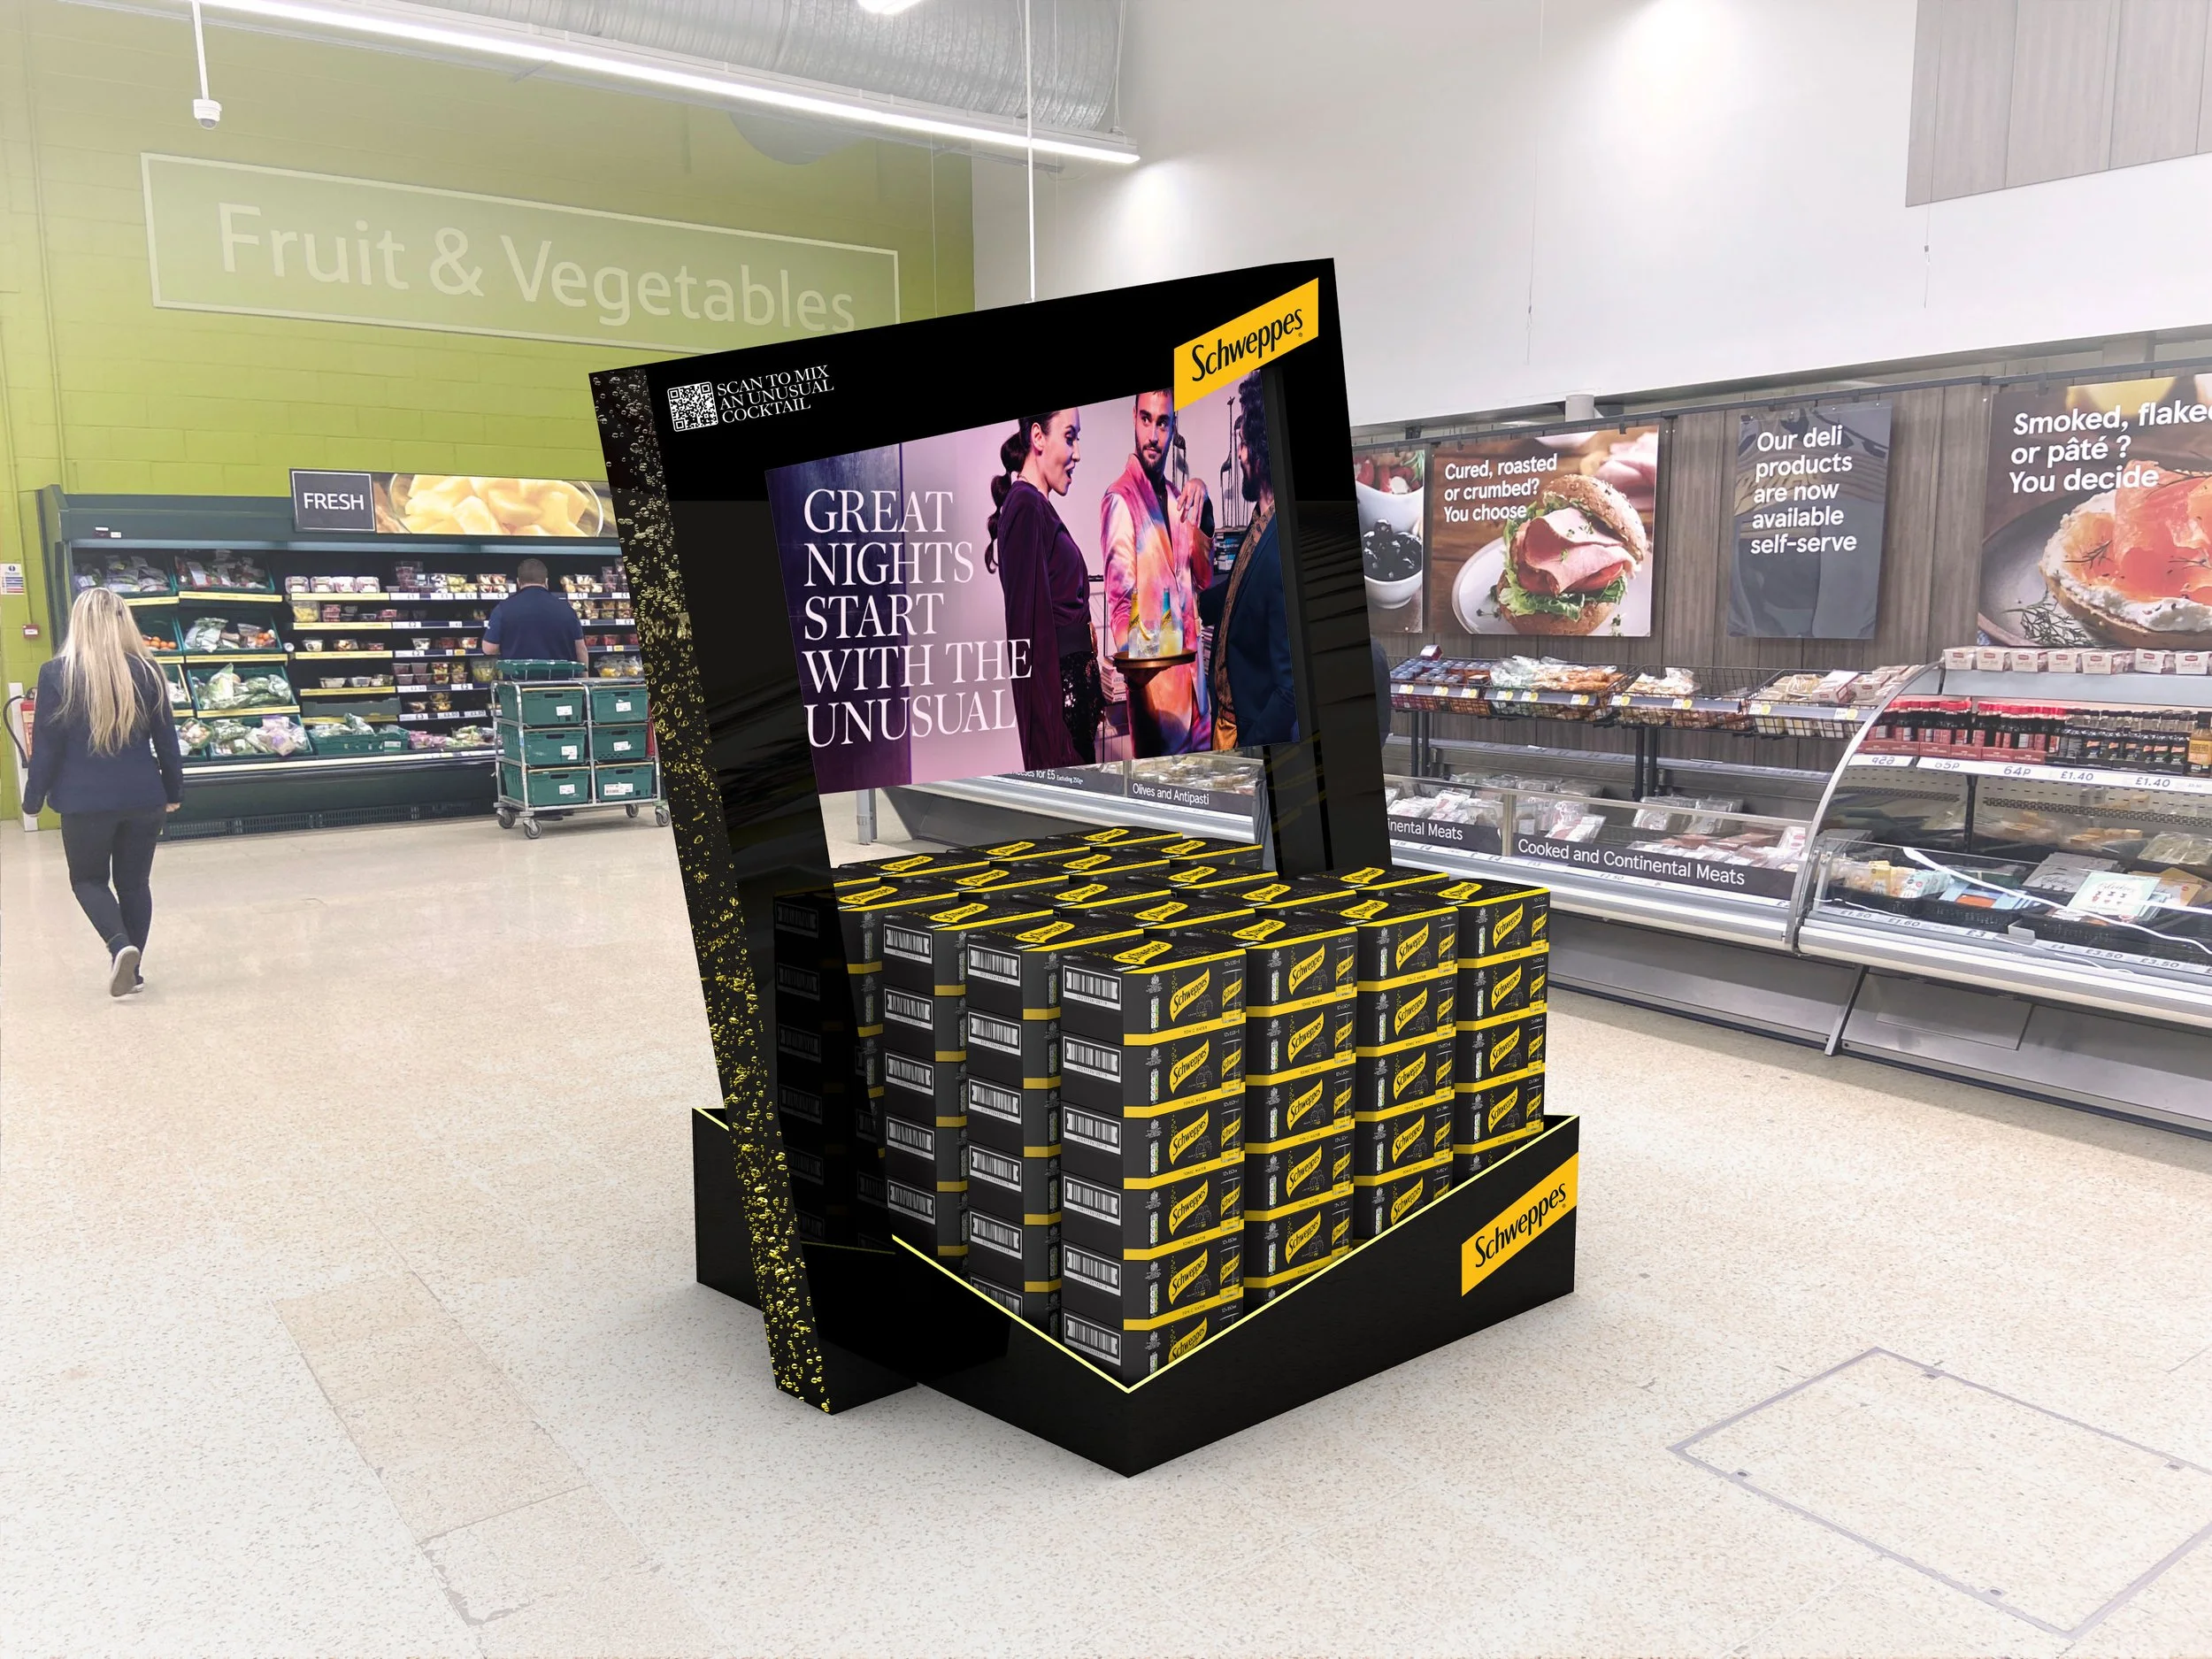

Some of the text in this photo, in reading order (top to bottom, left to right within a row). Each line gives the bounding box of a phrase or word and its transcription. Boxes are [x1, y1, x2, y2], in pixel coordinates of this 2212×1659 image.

[218, 202, 856, 333] Fruit & Vegetables
[1192, 309, 1303, 381] Schweppes
[717, 365, 830, 396] SCAN TO MIX
[720, 379, 834, 411] AN UNUSUAL
[721, 398, 811, 424] COCKTAIL
[2013, 399, 2212, 436] Smoked, flake
[1756, 424, 1843, 452] Our deli
[2010, 435, 2132, 469] or pâté ?
[1444, 453, 1557, 480] Cured, roasted
[1755, 453, 1853, 482] products
[2008, 465, 2160, 494] You decide
[303, 492, 365, 512] FRESH
[1444, 478, 1540, 502] or crumbed?
[1753, 482, 1839, 504] are now
[804, 488, 953, 534] GREAT
[1444, 503, 1526, 523] You choose
[1751, 506, 1844, 530] available
[1750, 532, 1858, 555] self-serve
[803, 541, 974, 587] NIGHTS
[804, 593, 944, 641] START
[802, 638, 1033, 694] WITH THE
[803, 689, 1017, 748] UNUSUAL
[1047, 769, 1056, 780] £5
[2003, 766, 2032, 776] 64p
[2061, 771, 2094, 781] £1.40
[2135, 777, 2170, 787] £1.40
[1133, 783, 1210, 805] Olives and Antipasti
[1387, 818, 1463, 841] inental Meats
[1518, 838, 1745, 886] Cooked and Continental Meats
[1399, 931, 1427, 963] Schweppes
[1965, 929, 1986, 938] £3
[1292, 953, 1323, 987] Schweppes
[2085, 949, 2124, 960] £3.50
[2139, 957, 2180, 969] £3.50
[1173, 977, 1207, 1013] Schweppes
[1397, 995, 1425, 1027] Schweppes
[1291, 1021, 1322, 1055] Schweppes
[1173, 1048, 1207, 1085] Schweppes
[1396, 1060, 1425, 1091] Schweppes
[1290, 1087, 1321, 1122] Schweppes
[1173, 1119, 1207, 1156] Schweppes
[1395, 1123, 1424, 1156] Schweppes
[1289, 1154, 1320, 1189] Schweppes
[1172, 1188, 1206, 1226] Schweppes
[1288, 1221, 1319, 1256] Schweppes
[1475, 1182, 1566, 1268] Schweppes
[1172, 1258, 1205, 1296] Schweppes
[1172, 1326, 1205, 1359] Schweppes
